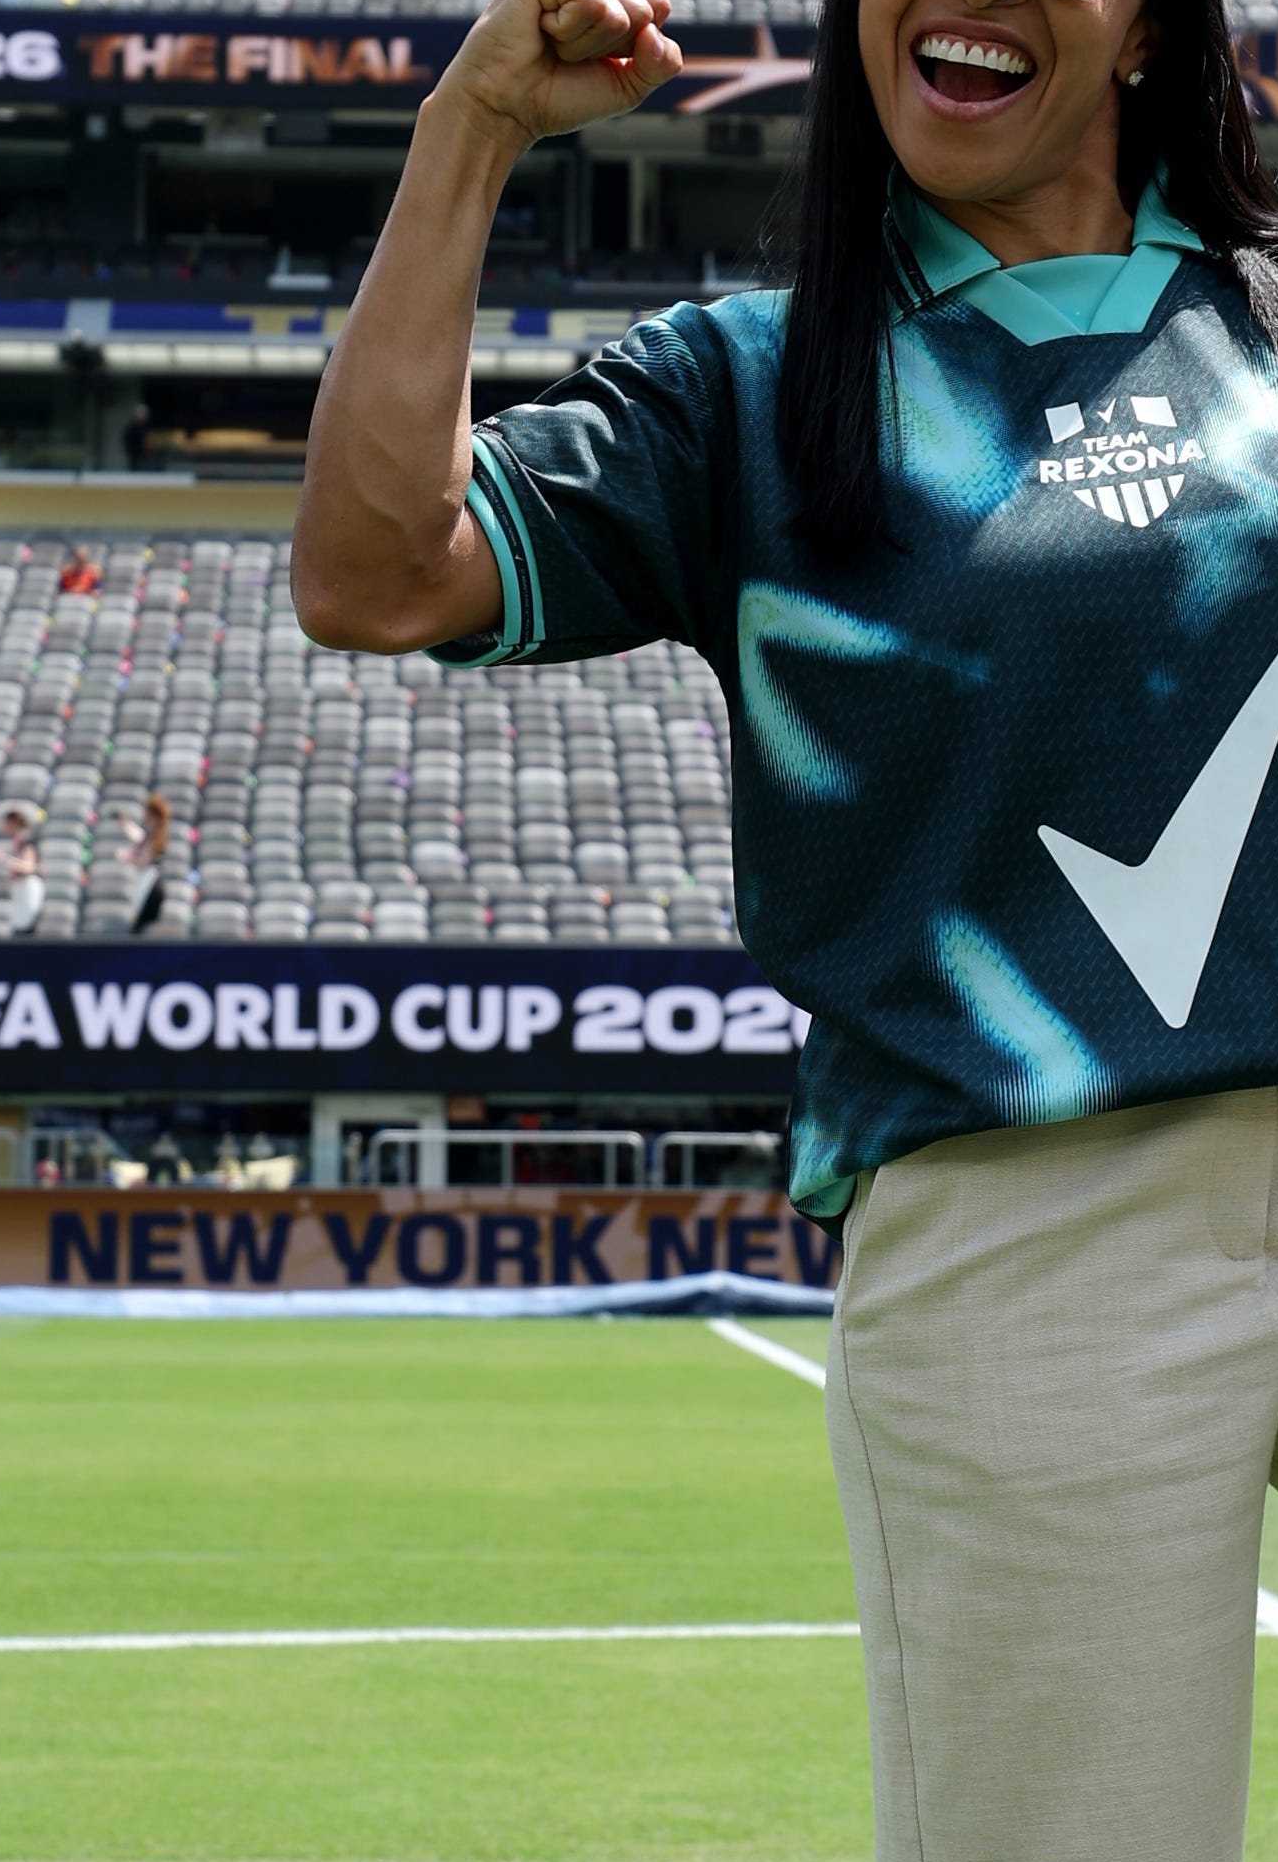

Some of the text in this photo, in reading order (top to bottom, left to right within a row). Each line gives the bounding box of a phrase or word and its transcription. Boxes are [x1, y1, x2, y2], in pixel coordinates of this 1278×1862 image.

[81, 32, 219, 82] THE
[225, 35, 427, 84] FINAL
[1039, 438, 1206, 484] REXONA
[1082, 430, 1149, 453] TEAM
[68, 982, 380, 1052] WORLD
[391, 983, 561, 1052] CUP
[573, 984, 812, 1053] 202
[48, 1210, 295, 1285] NEW
[321, 1212, 619, 1286] YORK
